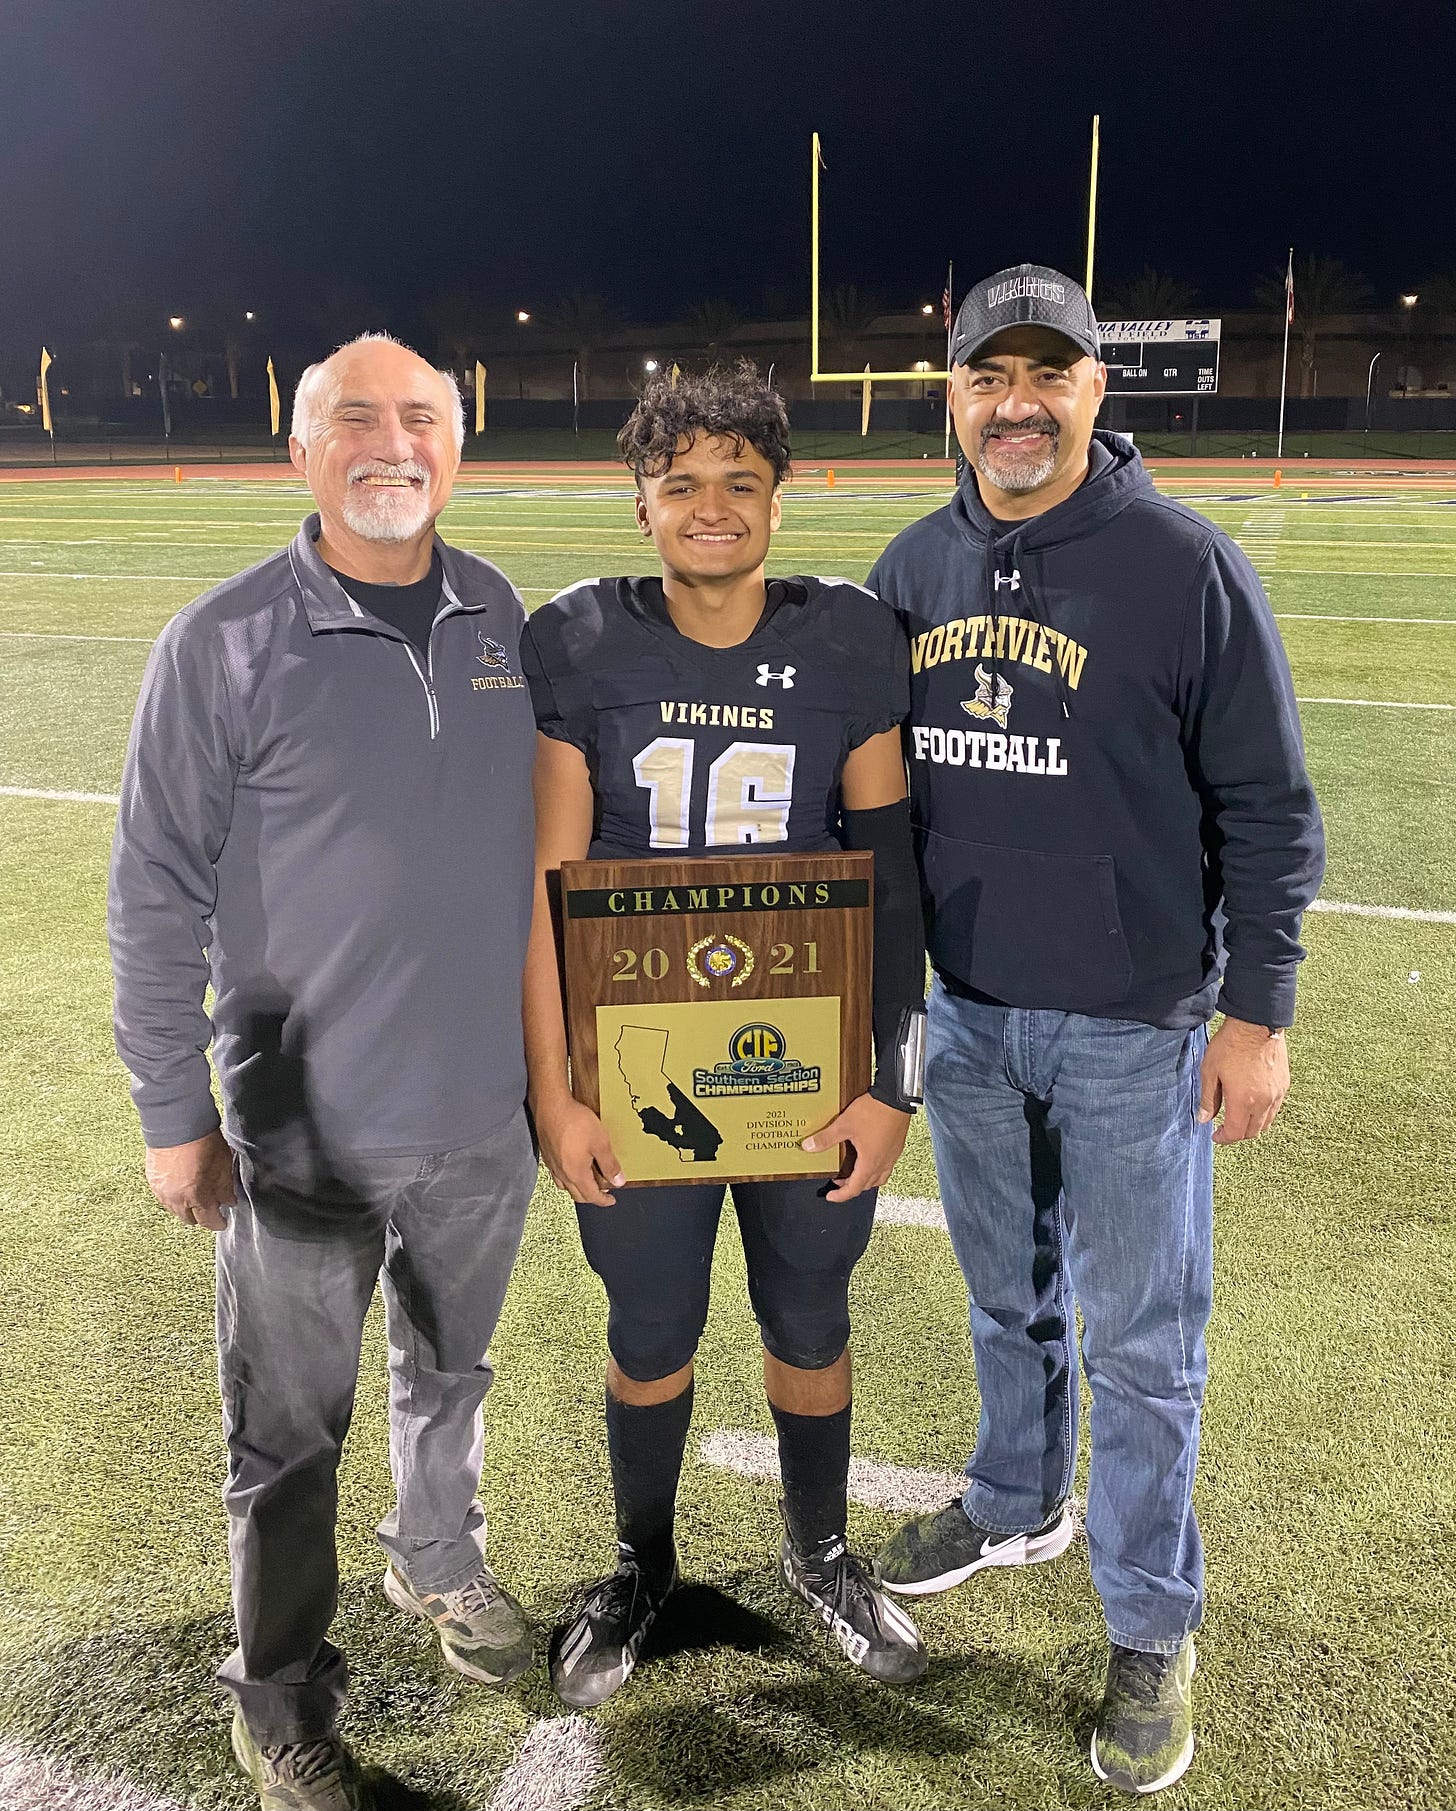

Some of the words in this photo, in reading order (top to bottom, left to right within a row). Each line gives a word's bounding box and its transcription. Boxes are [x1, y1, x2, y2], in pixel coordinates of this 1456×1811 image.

[987, 276, 1065, 308] VIKINGS
[1120, 321, 1174, 331] VALLEY
[1122, 368, 1138, 377] BALL
[1138, 368, 1148, 377] ON
[1163, 368, 1178, 377] QTR
[1197, 375, 1214, 383] OUTS
[1197, 383, 1213, 391] LEFT
[471, 676, 525, 690] FOOTBALL
[660, 701, 774, 729] VIKINGS
[912, 726, 1068, 775] FOOTBALL
[632, 737, 796, 848] 16
[608, 883, 830, 912] CHAMPIONS
[737, 1029, 778, 1059] CIF
[741, 1060, 775, 1073] Ford
[695, 1072, 760, 1085] Southern
[766, 1068, 819, 1084] Section
[695, 1079, 819, 1096] CHAMPIONSHIPS
[766, 1110, 786, 1118] 2021
[746, 1120, 793, 1129] DIVISION
[796, 1119, 806, 1127] 10
[751, 1130, 802, 1139] FOOTBALL
[745, 1141, 803, 1150] CHAMPION
